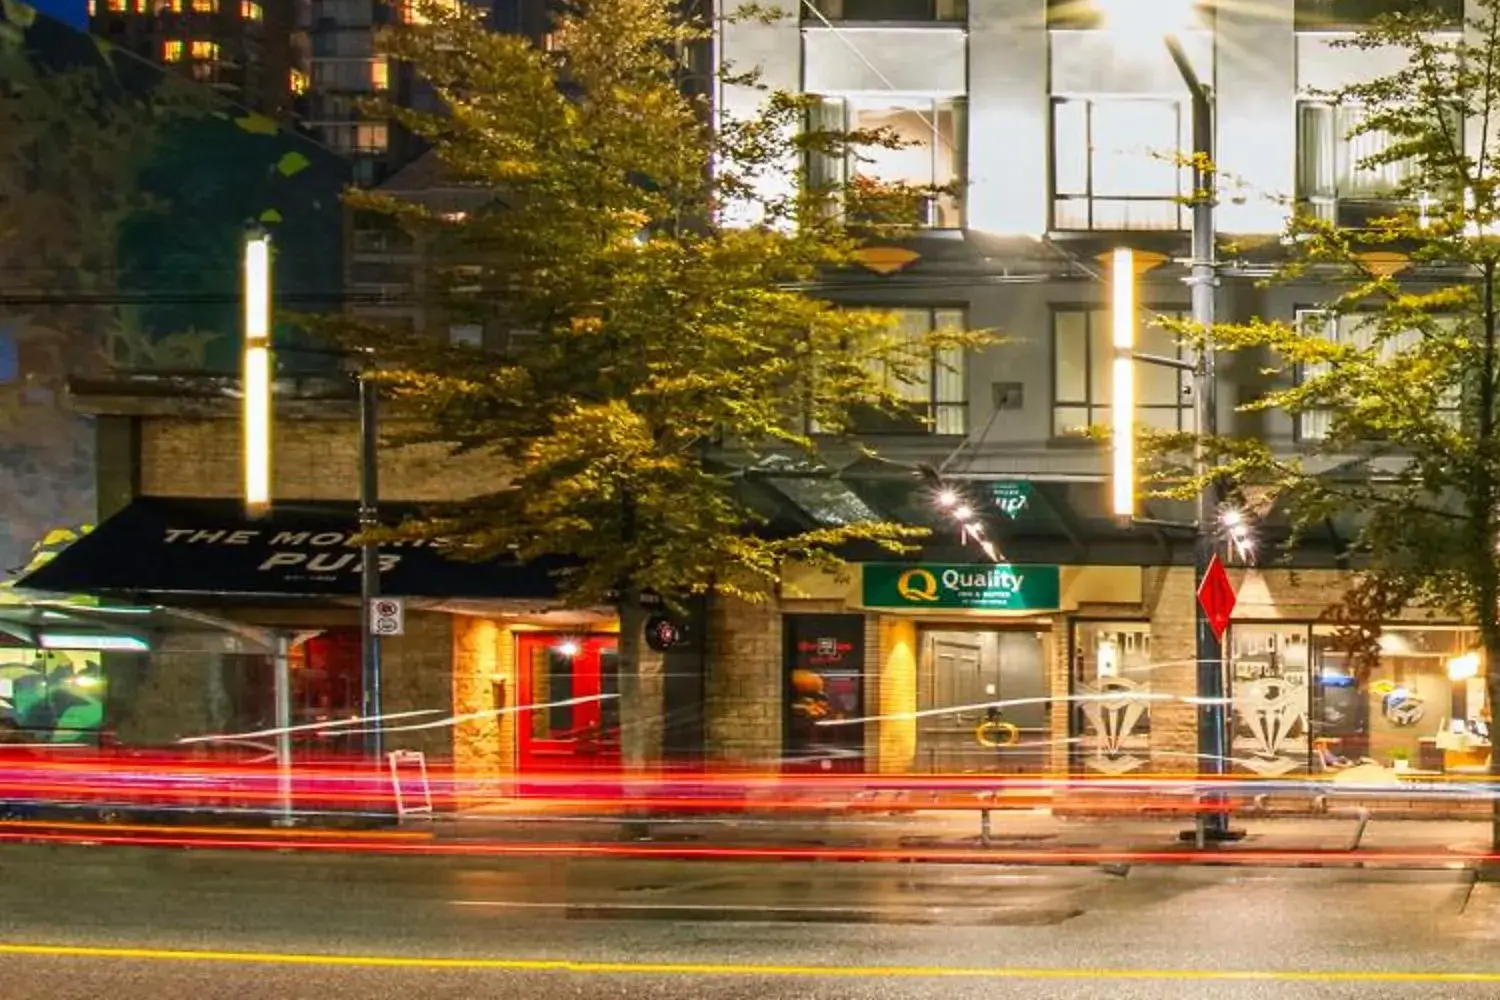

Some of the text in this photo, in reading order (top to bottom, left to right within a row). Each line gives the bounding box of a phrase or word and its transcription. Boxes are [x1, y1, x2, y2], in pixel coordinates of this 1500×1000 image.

[163, 529, 260, 544] THE
[257, 553, 402, 572] PUB
[941, 569, 1024, 593] Quality
